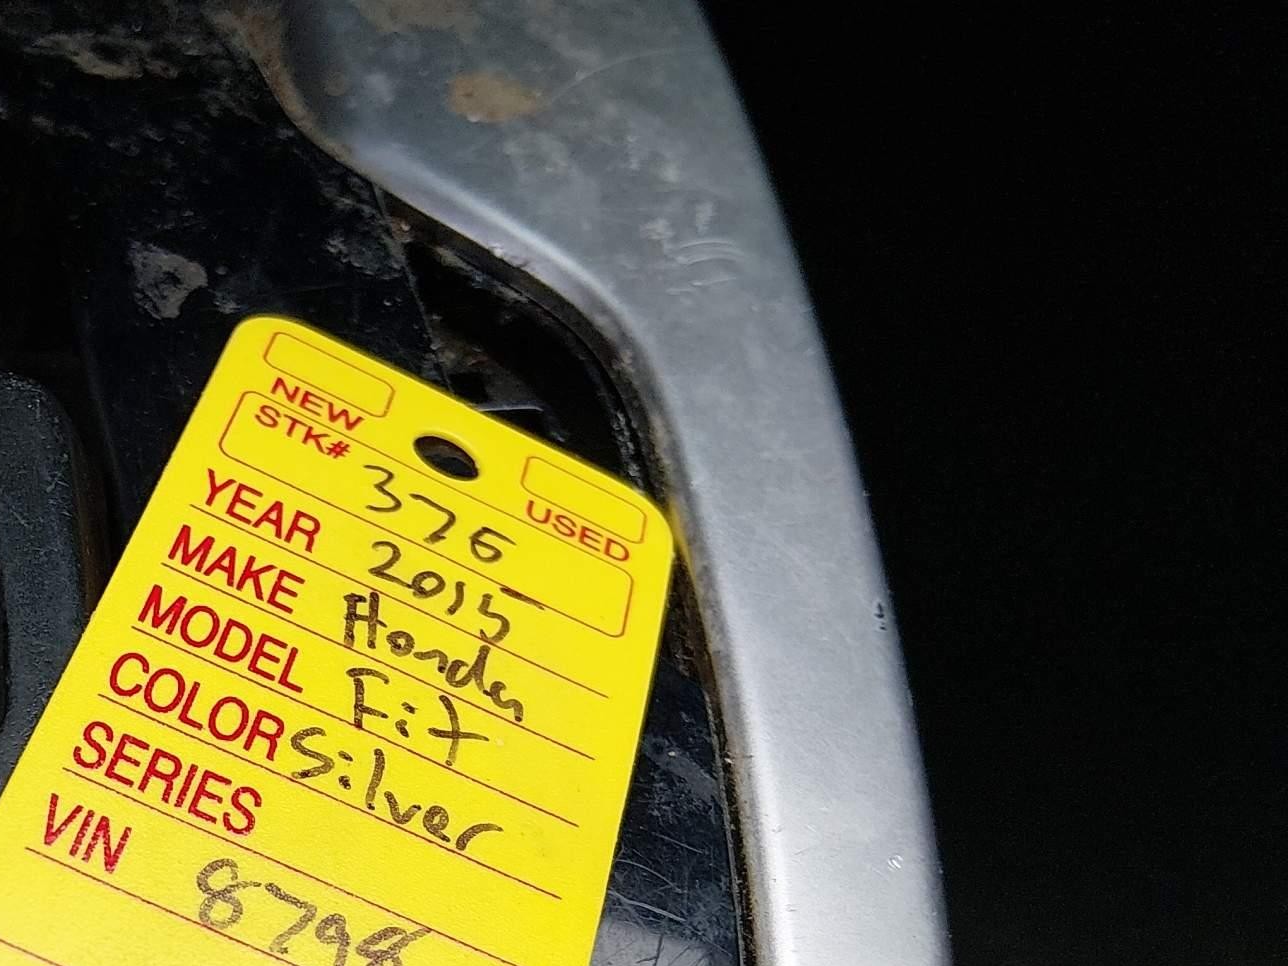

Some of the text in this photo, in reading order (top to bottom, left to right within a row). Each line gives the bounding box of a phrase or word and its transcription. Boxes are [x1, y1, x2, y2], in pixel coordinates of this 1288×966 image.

[255, 405, 351, 460] STK#
[271, 377, 364, 431] NEW
[206, 468, 321, 553] YEAR
[525, 501, 630, 563] USED
[168, 524, 305, 614] MAKE
[367, 540, 544, 644] 2015
[137, 584, 304, 693] MODEL
[343, 591, 524, 722] Honda
[109, 652, 285, 761] COLOR
[346, 668, 489, 766] Fit
[73, 721, 262, 836] SERIES
[291, 727, 503, 851] Silver
[41, 793, 132, 875] VIN
